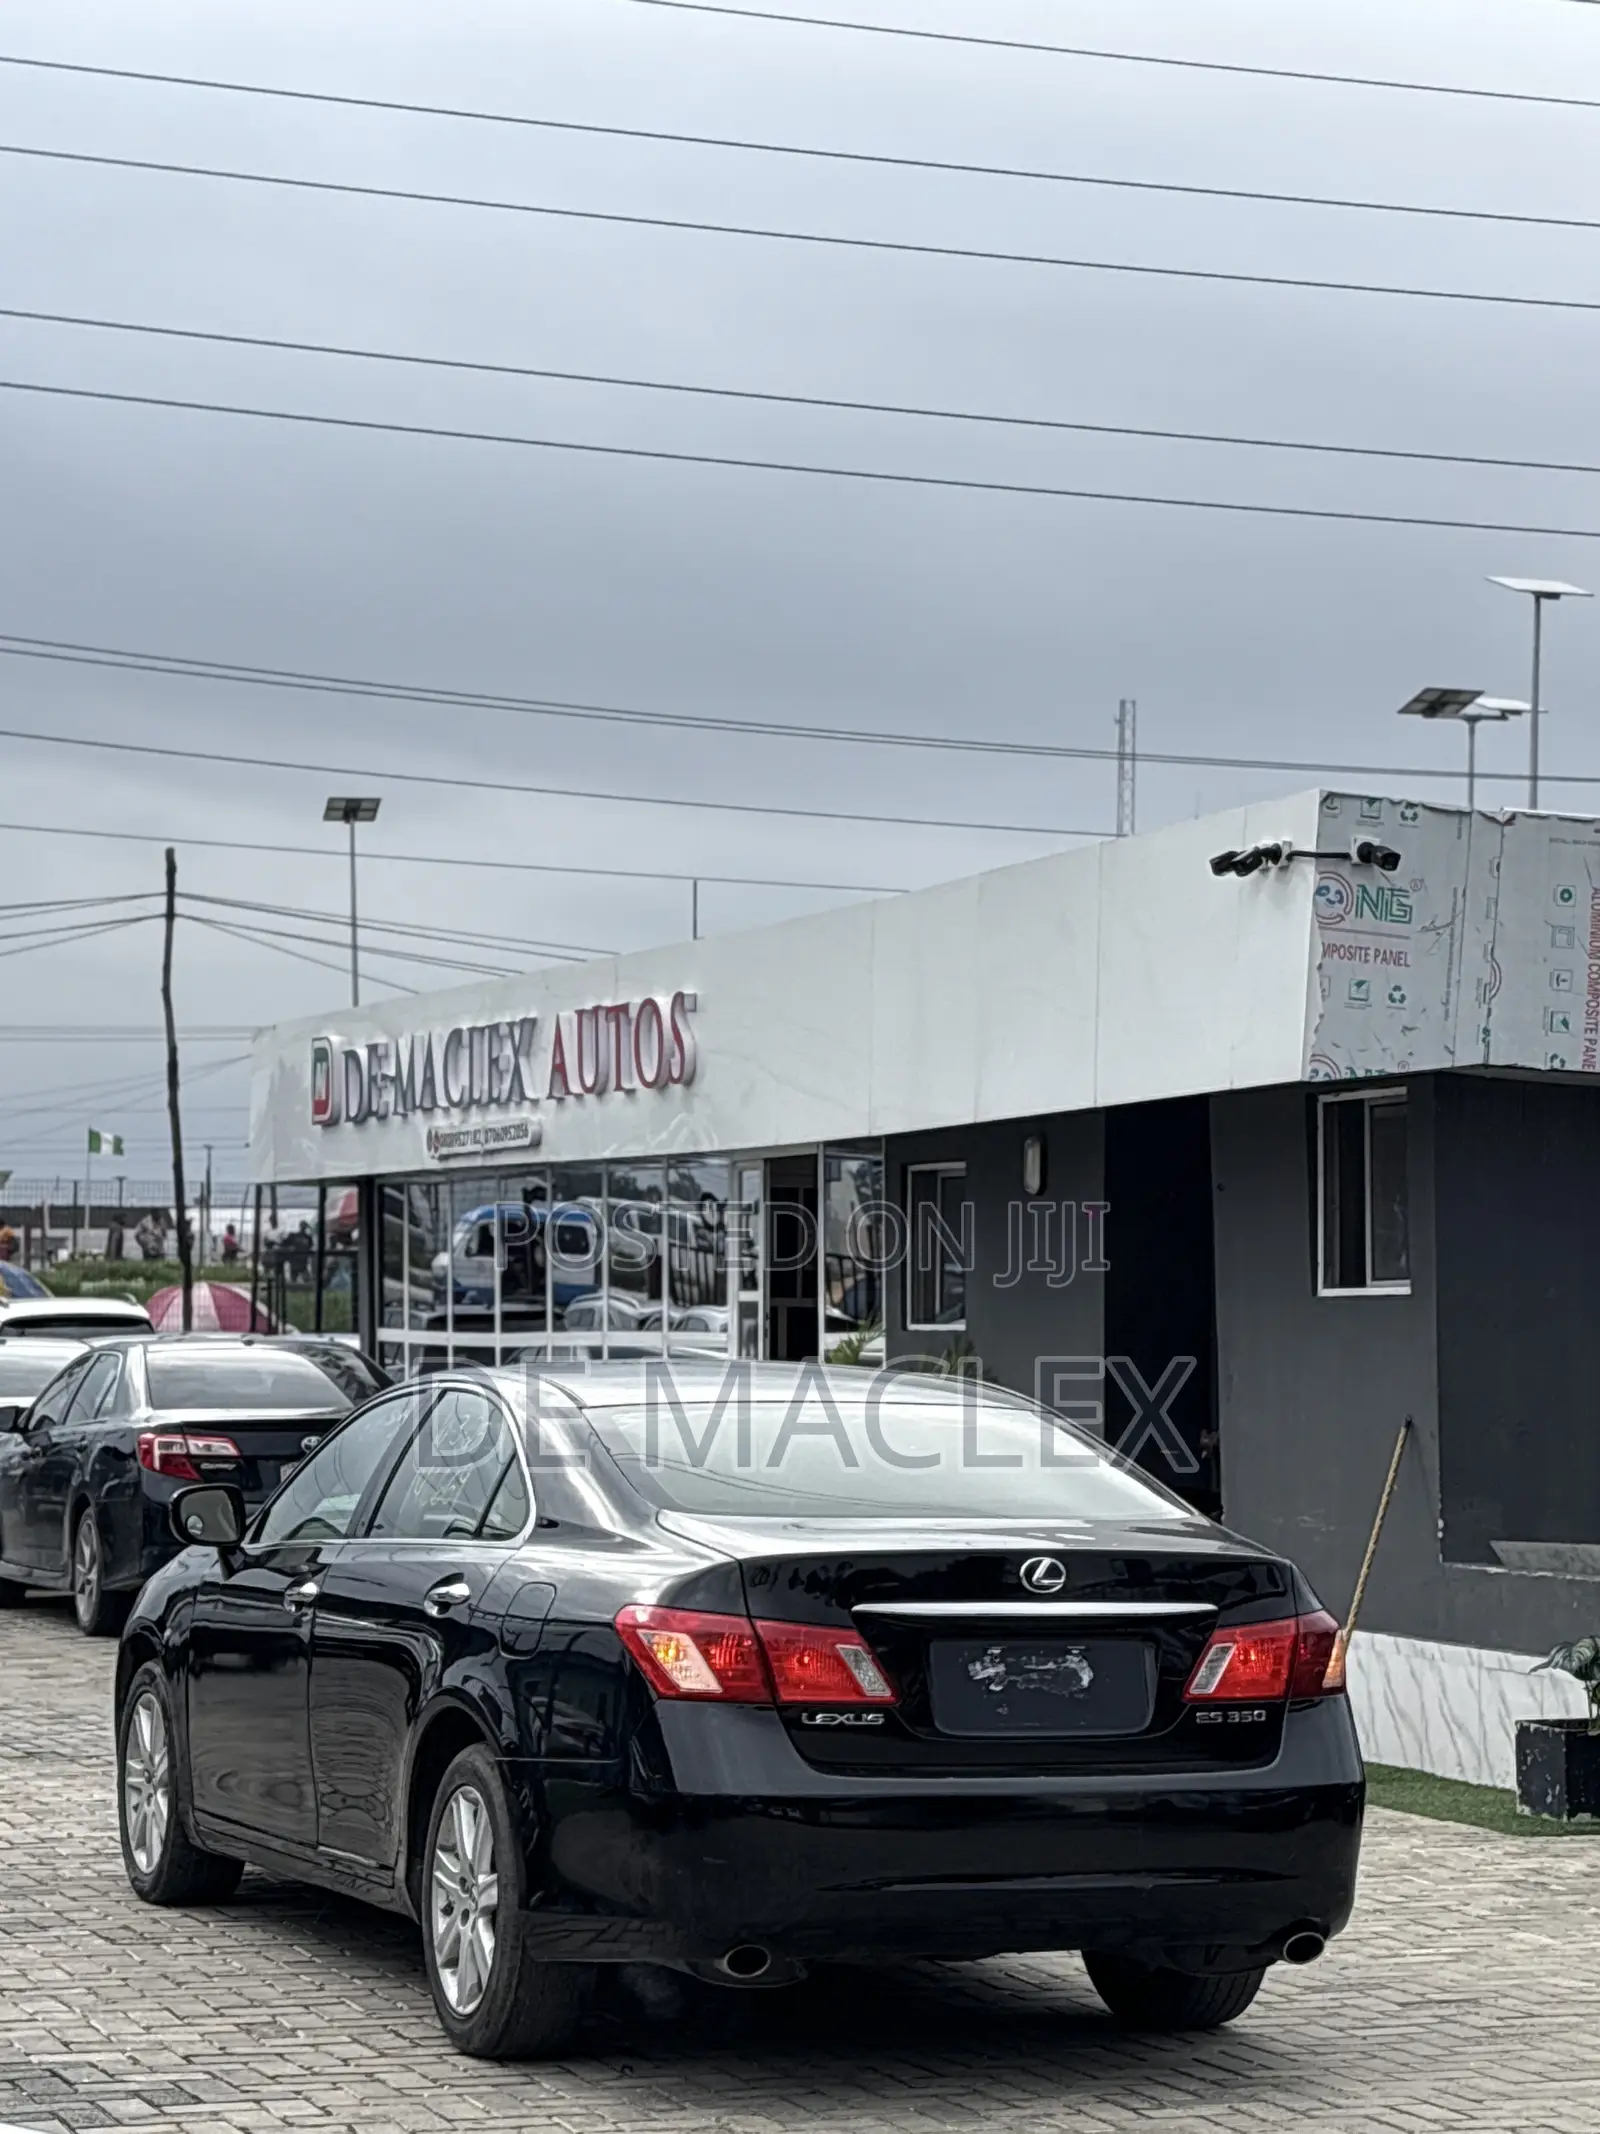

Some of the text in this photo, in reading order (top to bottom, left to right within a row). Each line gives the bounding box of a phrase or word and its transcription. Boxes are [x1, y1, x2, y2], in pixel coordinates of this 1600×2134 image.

[1373, 947, 1411, 968] PANEL
[546, 990, 698, 1101] AUTOS
[801, 1712, 885, 1725] LEXUS
[1195, 1709, 1267, 1724] ES 350
